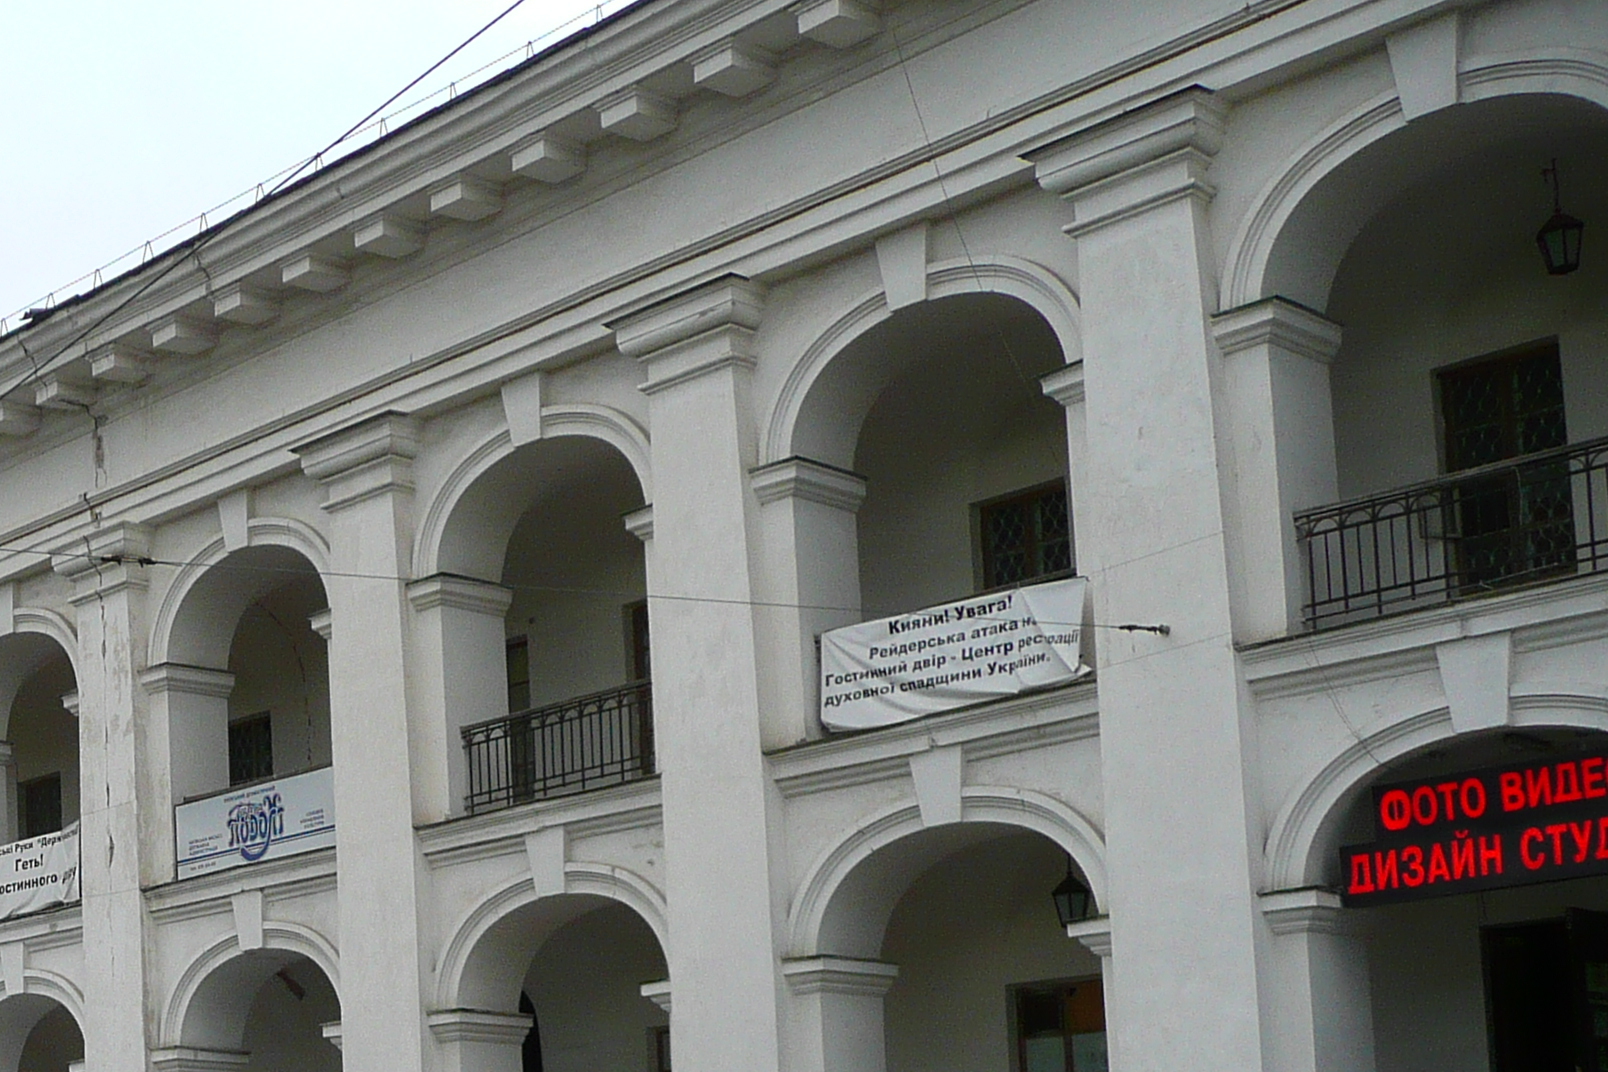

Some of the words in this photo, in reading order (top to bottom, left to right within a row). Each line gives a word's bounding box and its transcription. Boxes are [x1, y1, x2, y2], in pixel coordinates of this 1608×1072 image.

[889, 610, 949, 635] Кияни!
[955, 595, 1012, 622] Увага!
[869, 632, 966, 660] Рейдерська
[970, 618, 1019, 643] атака
[825, 661, 909, 687] Гостинний
[912, 653, 947, 675] двір
[962, 641, 1015, 665] Центр
[824, 682, 896, 708] духовної
[900, 666, 983, 692] спадщини
[1380, 777, 1487, 831] ФОТО
[1500, 757, 1608, 812] ВИДЕ
[15, 853, 44, 872] Геть!
[1348, 829, 1504, 895] ДИЗАЙН
